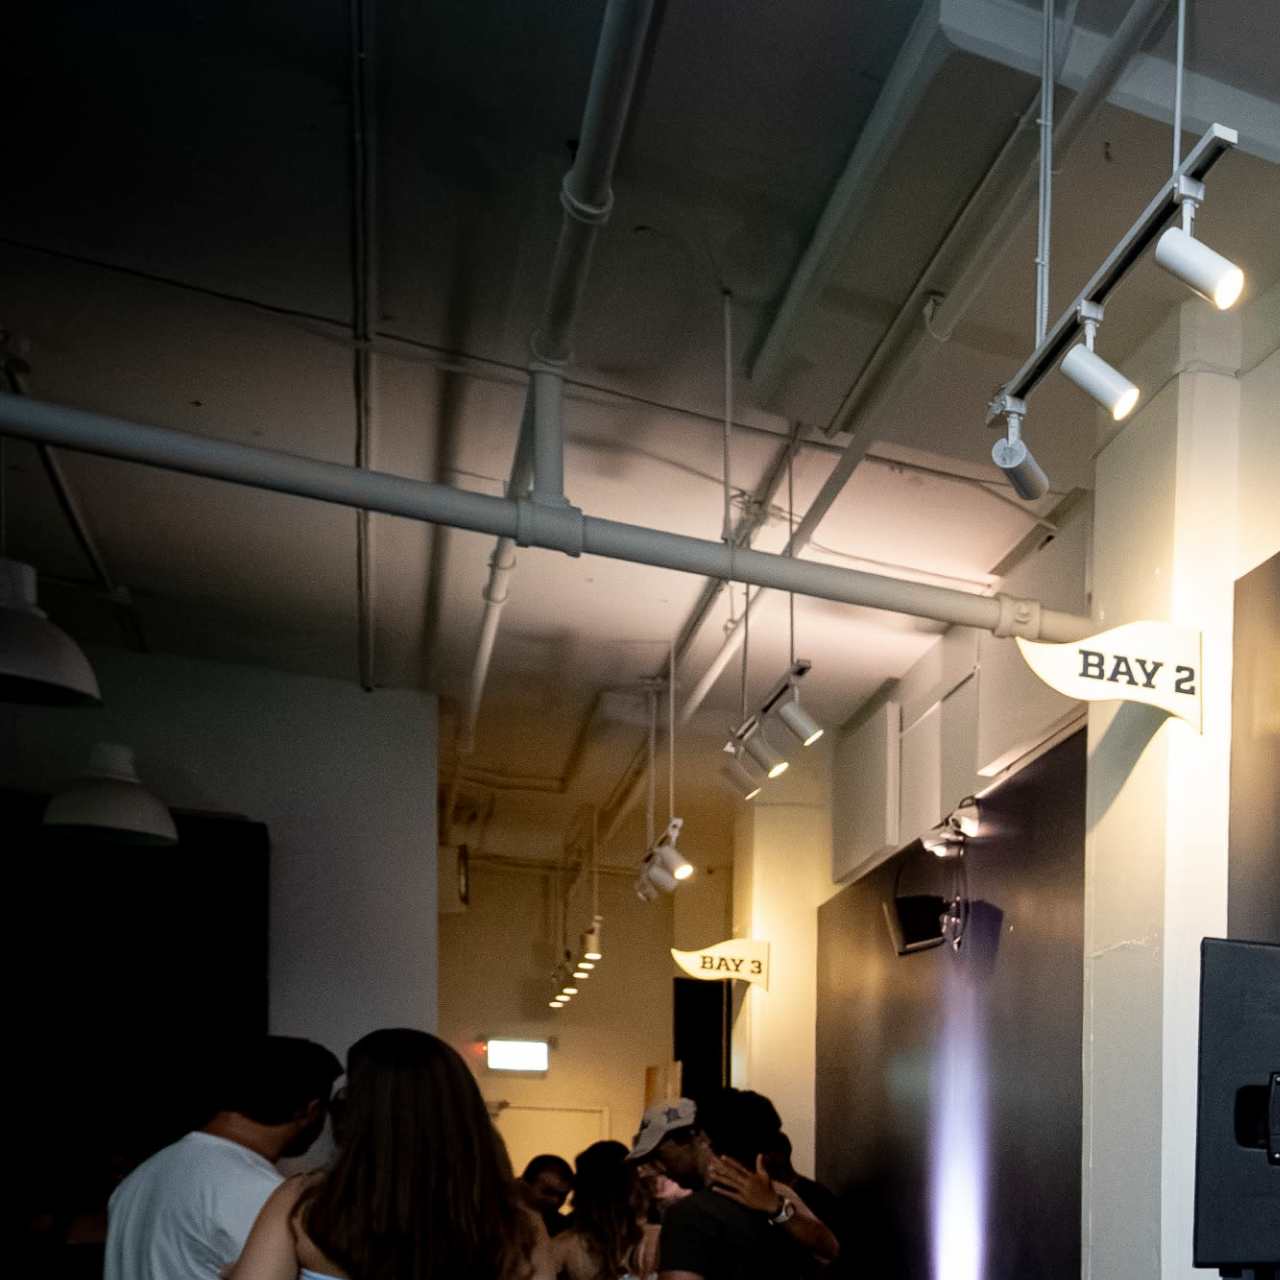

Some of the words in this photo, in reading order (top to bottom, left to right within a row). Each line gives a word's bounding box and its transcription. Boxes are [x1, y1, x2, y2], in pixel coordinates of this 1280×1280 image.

[1078, 649, 1163, 689] BAY
[1173, 665, 1196, 696] 2
[700, 954, 745, 974] BAY
[750, 958, 763, 976] 3
